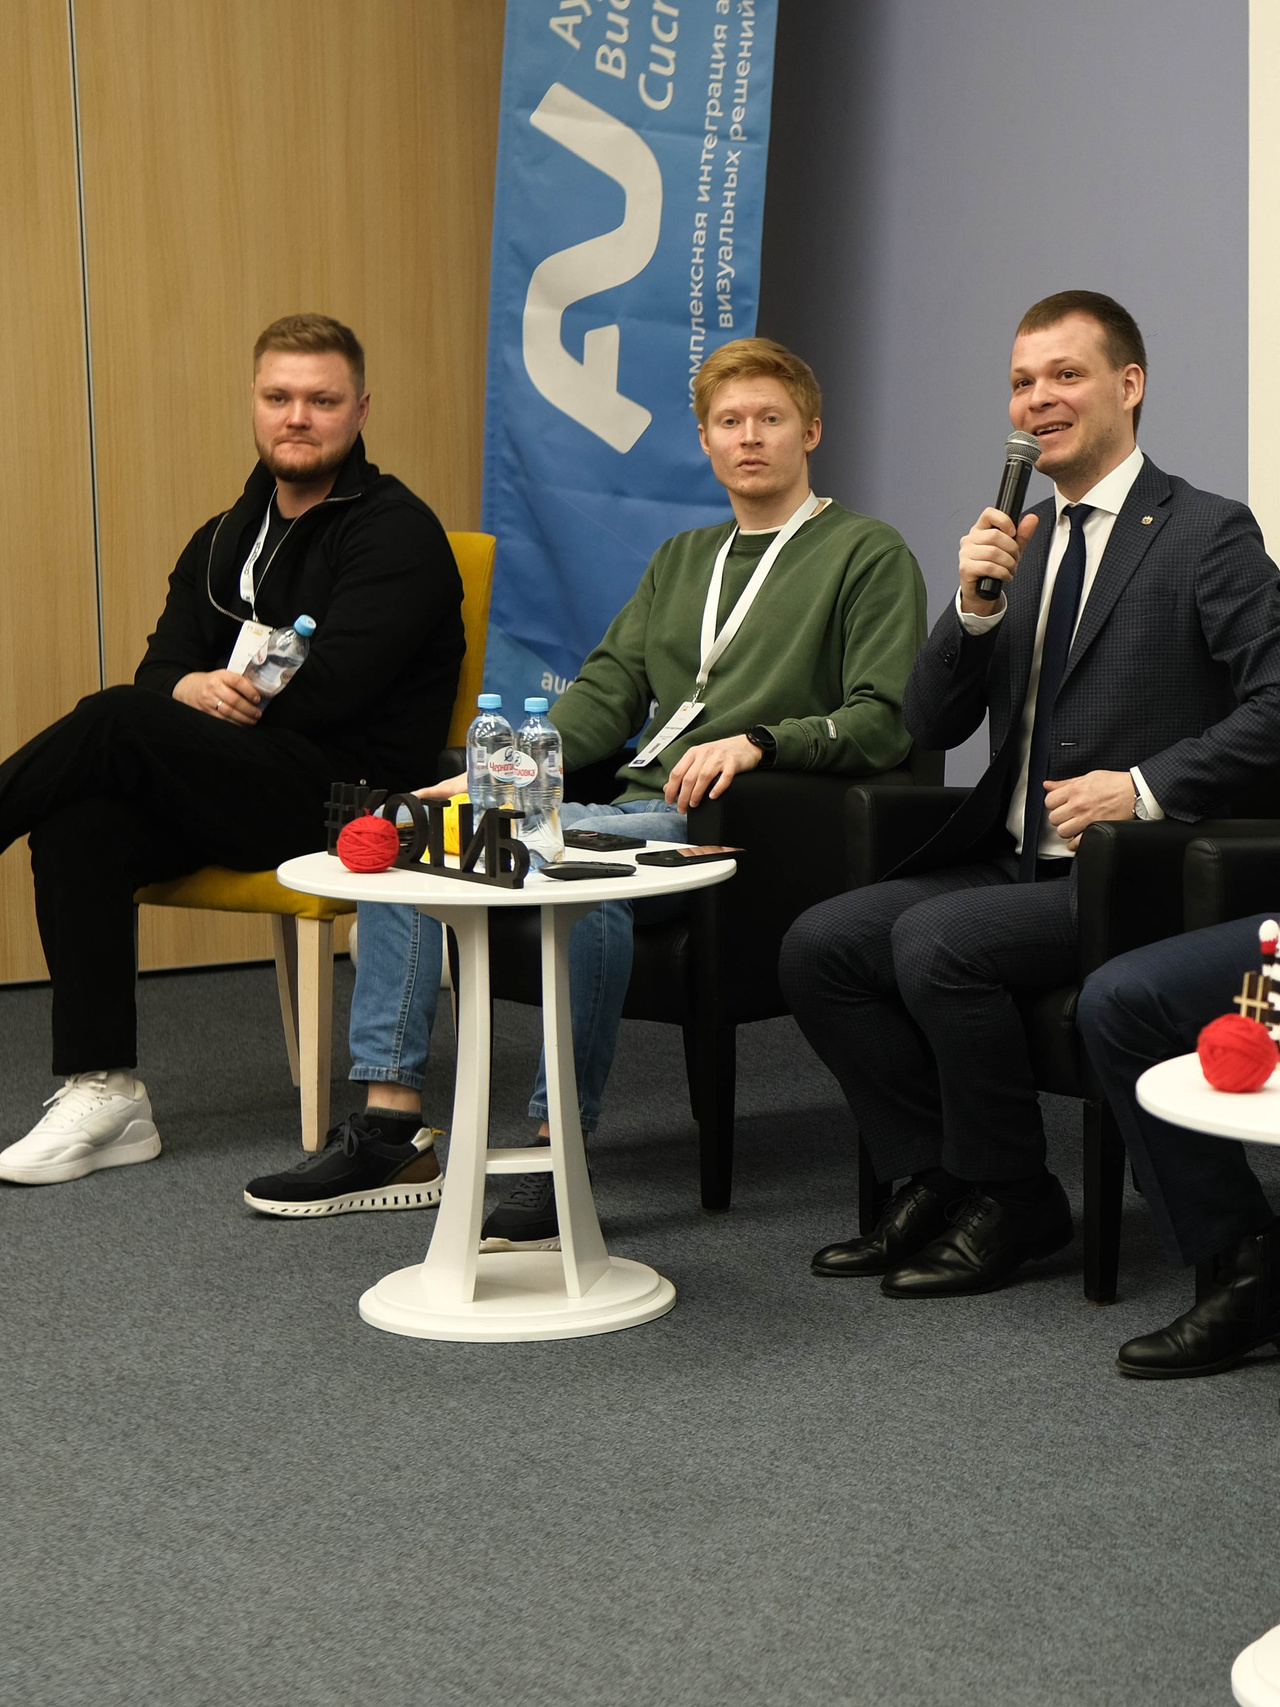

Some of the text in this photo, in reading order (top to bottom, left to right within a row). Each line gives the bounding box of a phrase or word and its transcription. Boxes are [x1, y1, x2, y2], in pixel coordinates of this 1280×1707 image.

[696, 24, 728, 202] интеграция
[718, 0, 756, 328] визуальных решений
